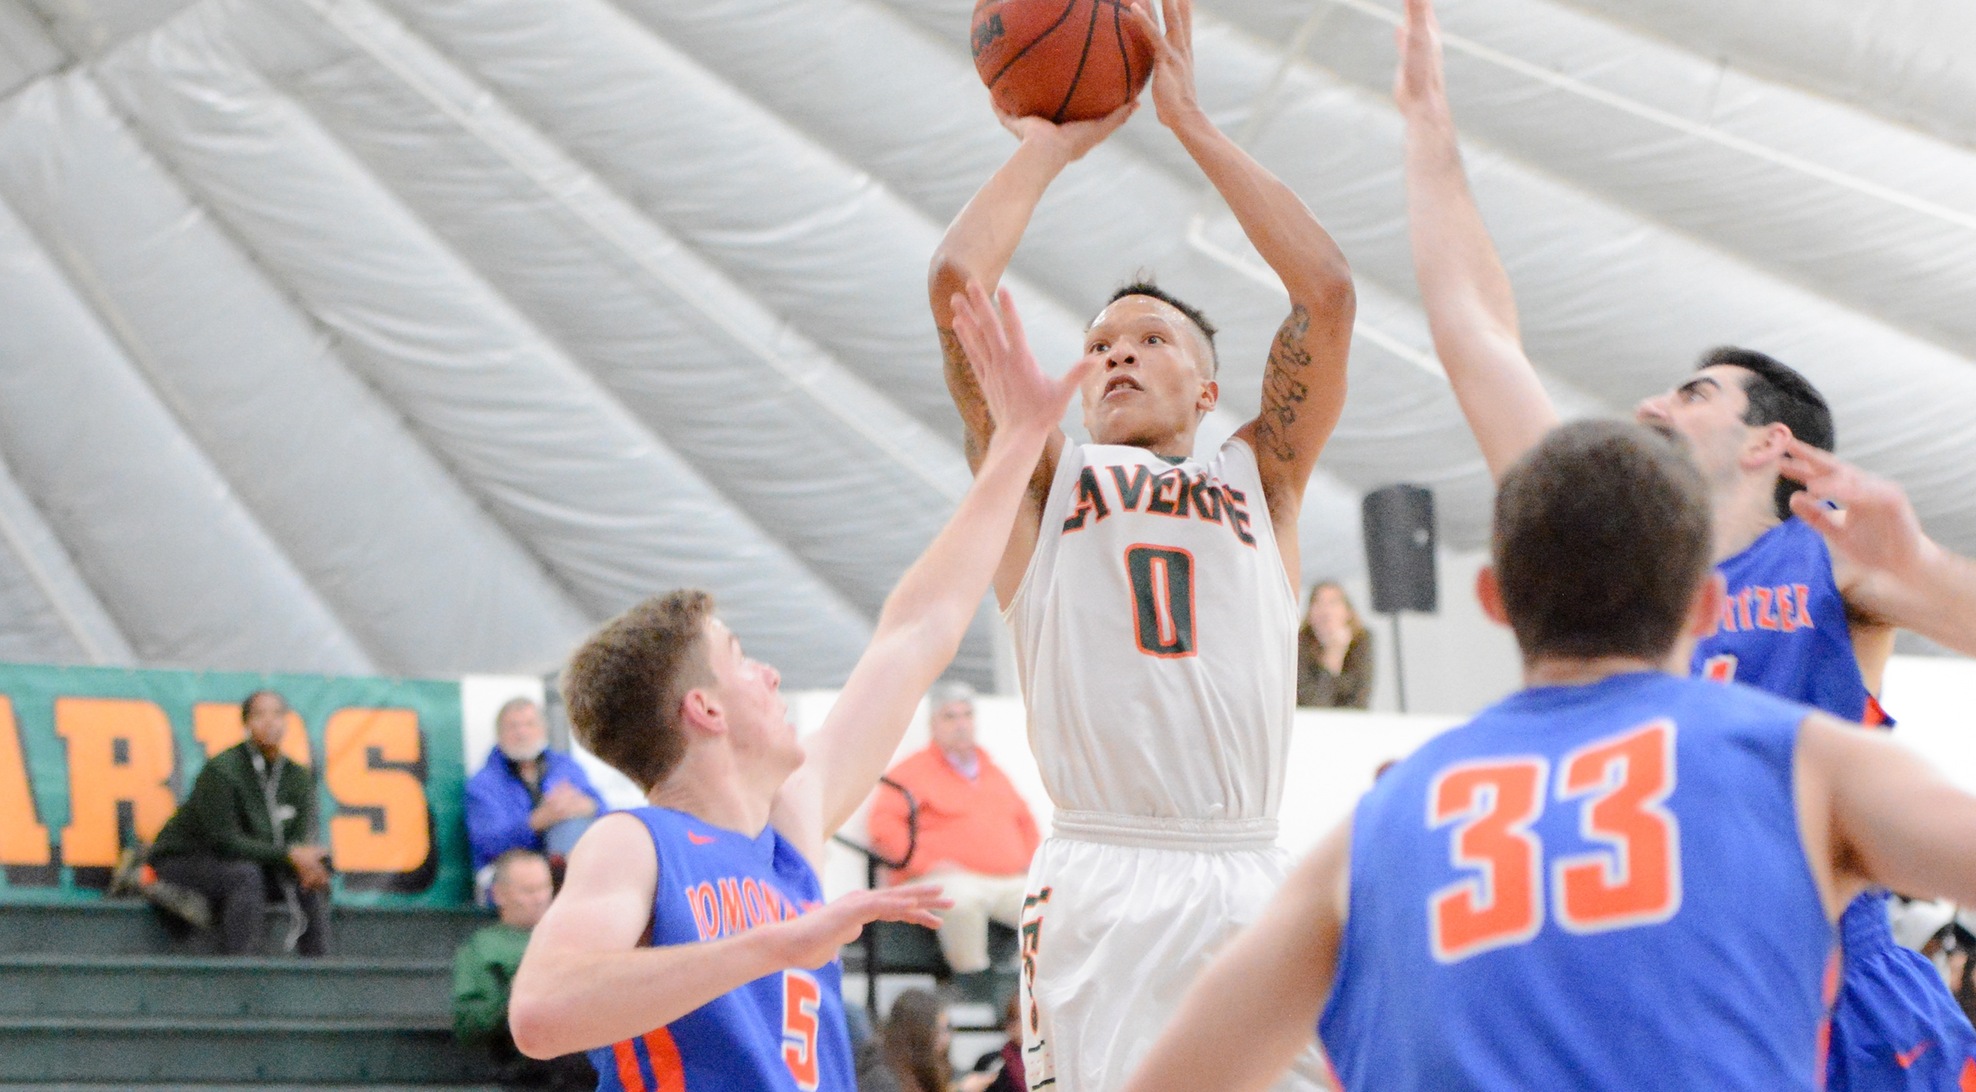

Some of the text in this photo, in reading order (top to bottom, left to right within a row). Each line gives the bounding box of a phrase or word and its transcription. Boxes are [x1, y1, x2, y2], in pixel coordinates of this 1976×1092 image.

[1124, 542, 1198, 659] 0
[1426, 717, 1683, 964] 33
[781, 967, 822, 1091] 5
